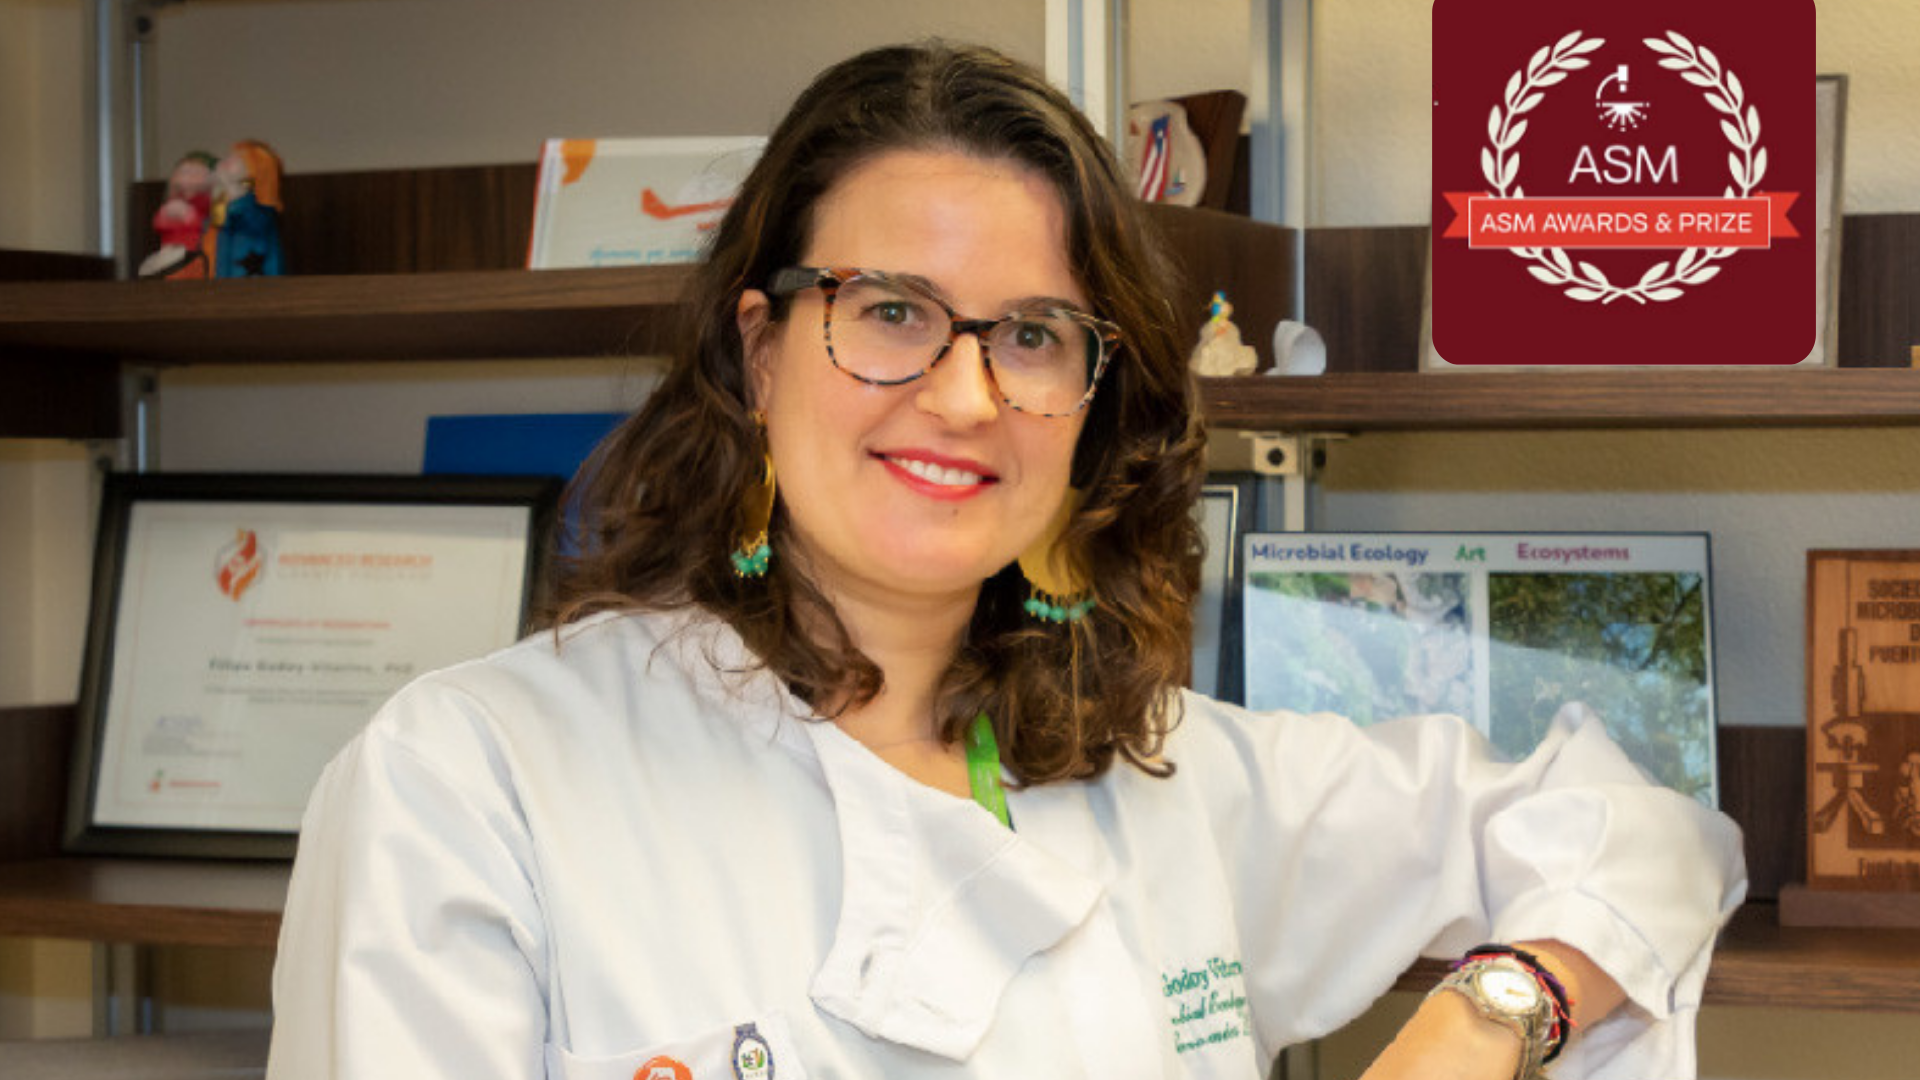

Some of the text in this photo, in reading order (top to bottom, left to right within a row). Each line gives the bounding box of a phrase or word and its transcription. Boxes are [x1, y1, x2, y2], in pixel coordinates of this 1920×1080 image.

[1252, 542, 1630, 565] Microbial Ecology Art Ecosystems
[1869, 645, 1920, 664] PUERT
